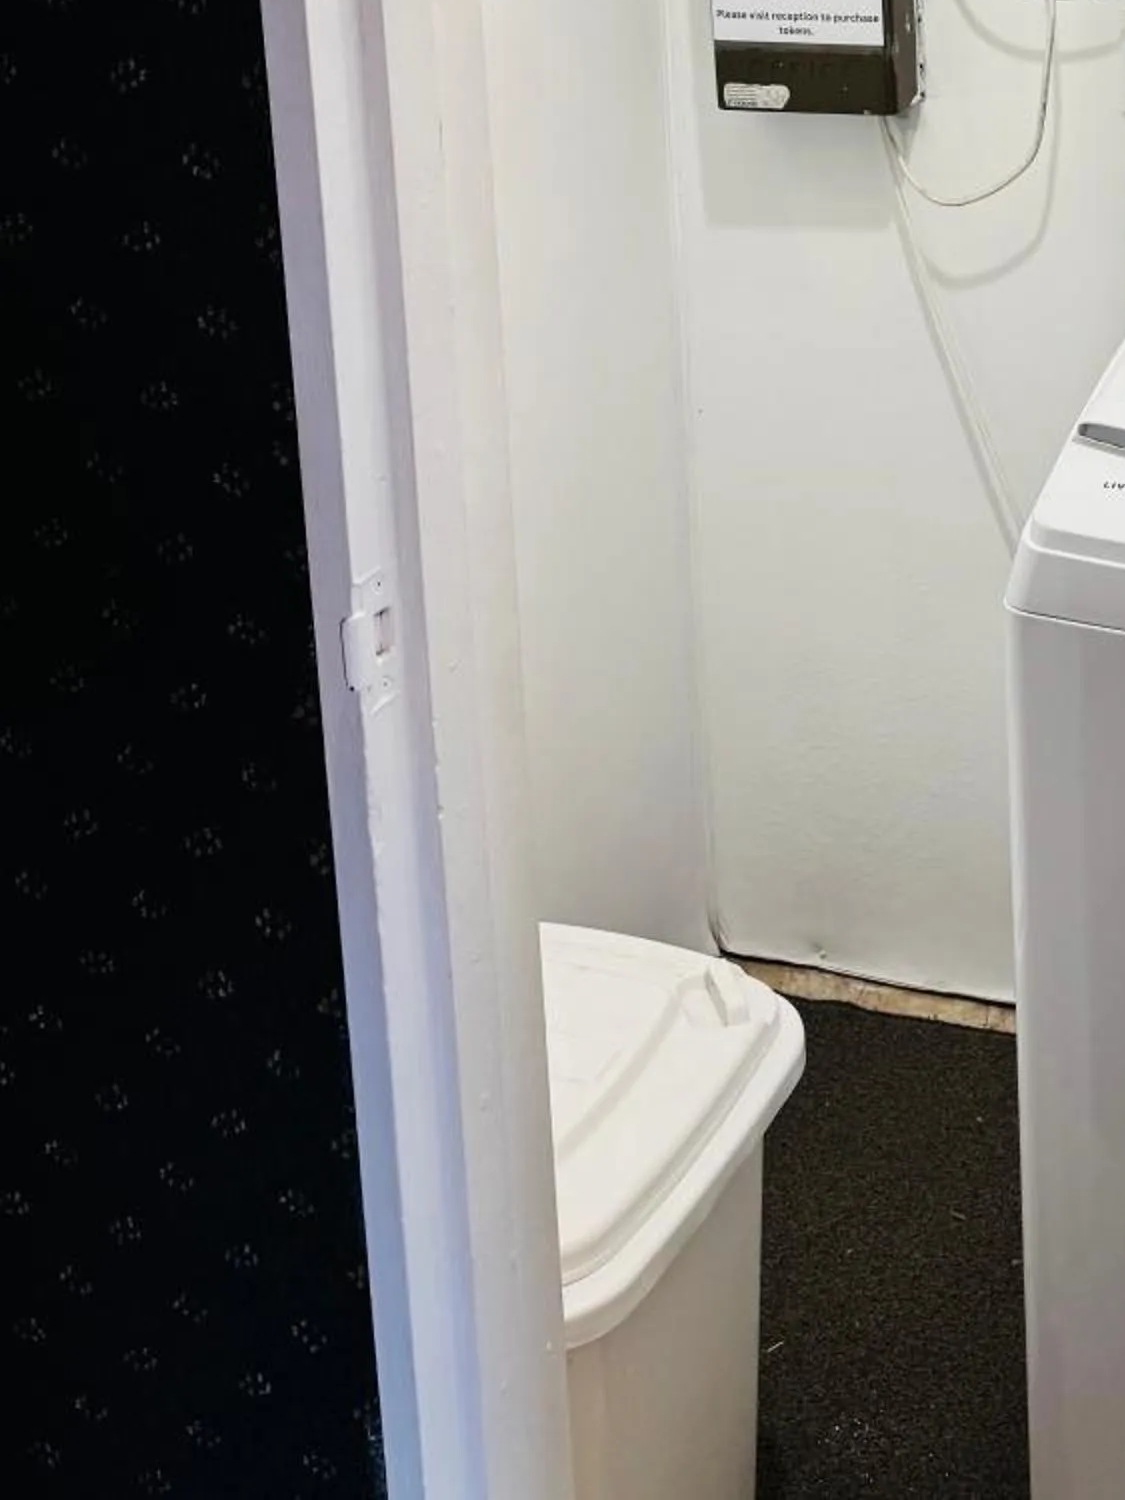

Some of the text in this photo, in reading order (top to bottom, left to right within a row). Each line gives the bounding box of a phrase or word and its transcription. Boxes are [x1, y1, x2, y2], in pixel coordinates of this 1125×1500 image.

[716, 9, 879, 24] Please visit reception to purchase
[779, 26, 814, 36] tokens.
